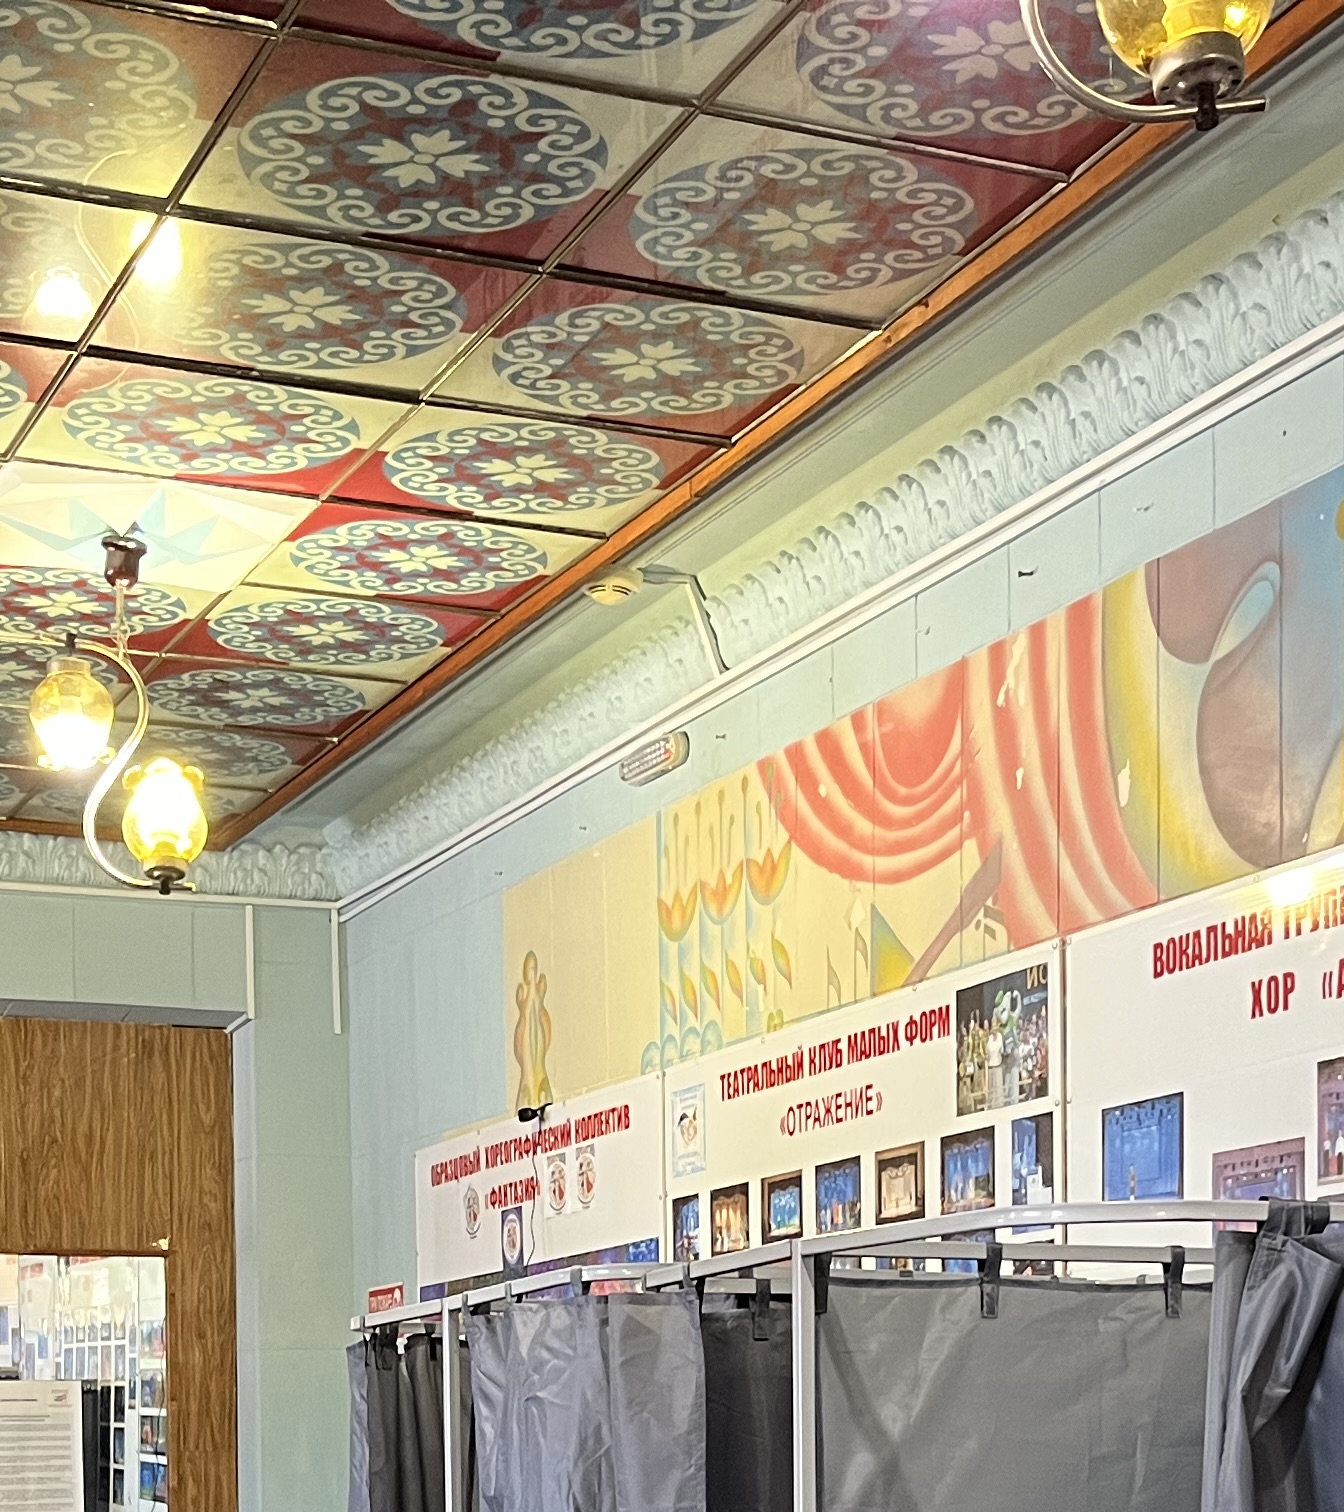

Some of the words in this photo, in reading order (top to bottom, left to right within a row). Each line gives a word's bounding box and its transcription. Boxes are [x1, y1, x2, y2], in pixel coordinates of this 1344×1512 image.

[1153, 908, 1272, 979] ВОКАЛЬНАЯ
[1250, 971, 1295, 1019] ХОР
[720, 1046, 804, 1102] ТЕАТРАЛЬНЫЙ
[808, 1037, 843, 1076] КЛУБ
[847, 1019, 900, 1066] МАЛЫХ
[904, 1004, 951, 1046] ФОРМ
[431, 1146, 481, 1187] ОБРАЗЦОВЫЙ
[485, 1118, 572, 1169] ХОРЕОГРАФИЧЕСКИЙ
[574, 1104, 630, 1144] КОЛЛЕКТИВ
[780, 1083, 883, 1137] «ОТРАЖЕНИЕ»
